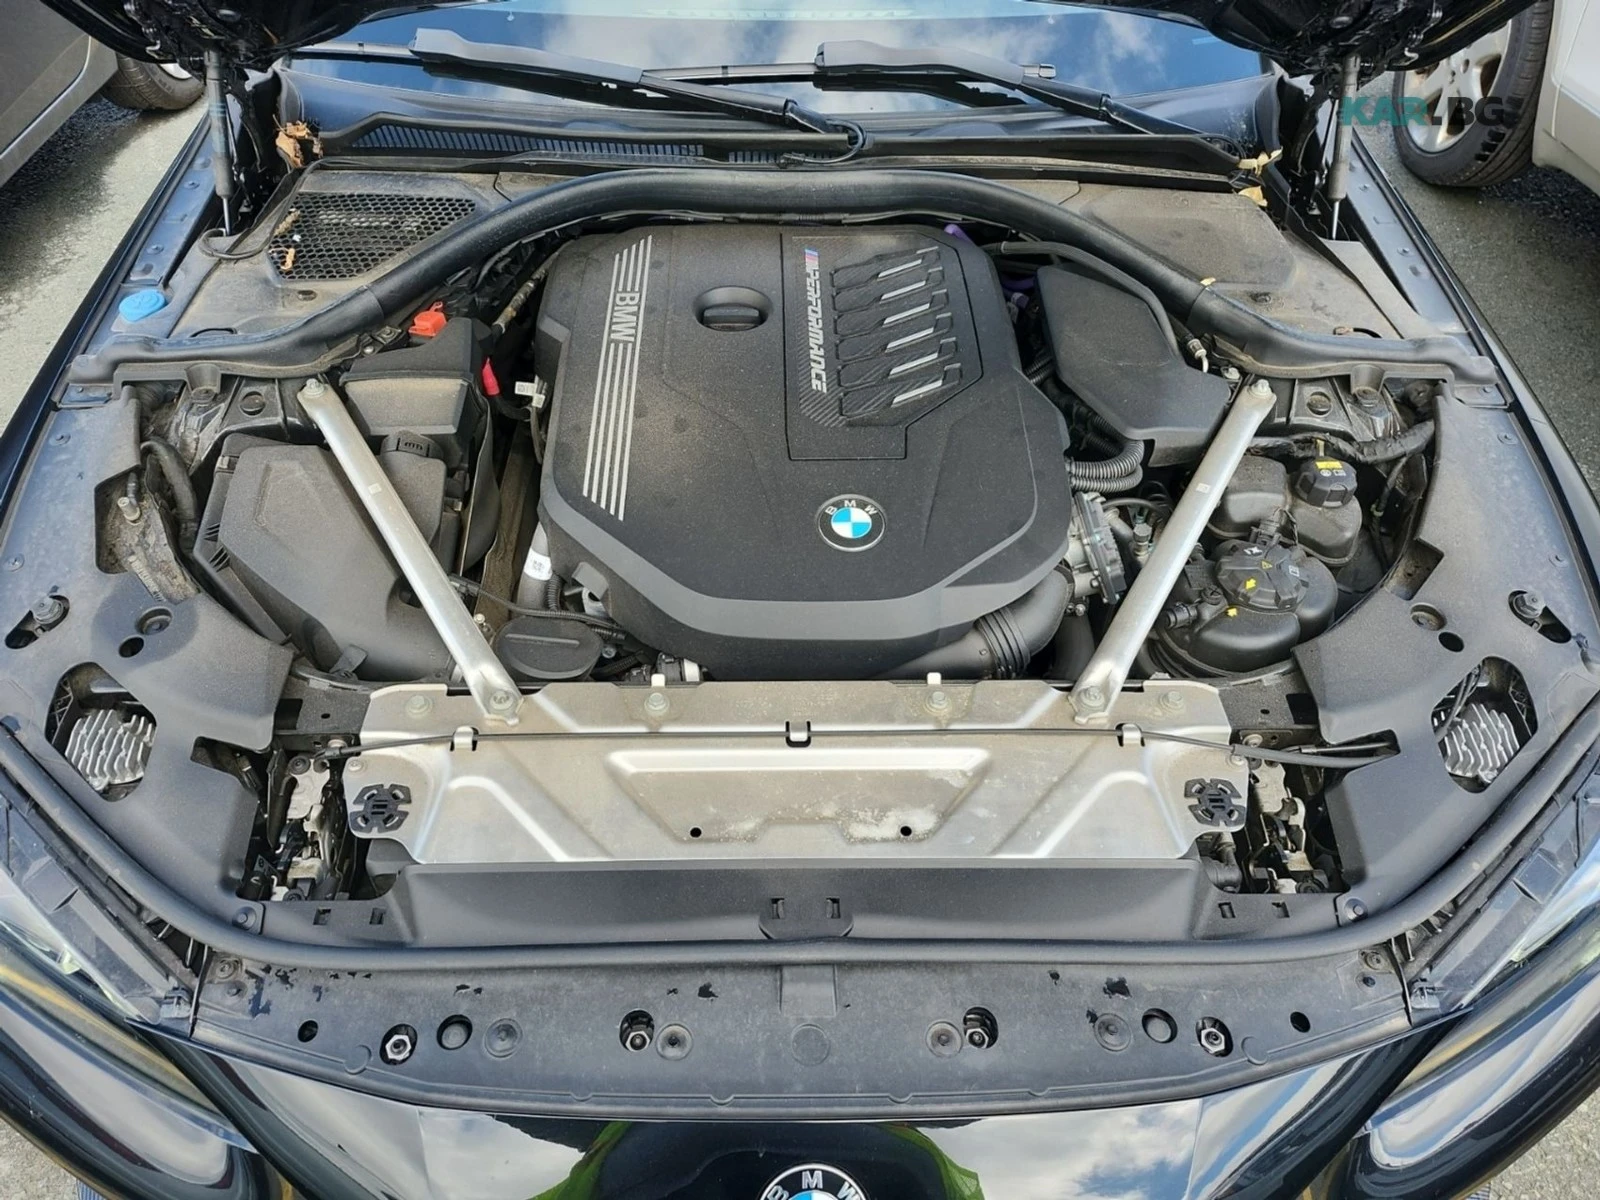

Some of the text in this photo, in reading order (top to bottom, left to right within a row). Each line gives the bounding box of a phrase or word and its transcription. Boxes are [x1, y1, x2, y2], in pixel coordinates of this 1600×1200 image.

[610, 292, 640, 342] BMW
[806, 267, 827, 393] PERFORMANCE
[825, 500, 878, 515] BMW
[767, 1170, 862, 1200] BMW
